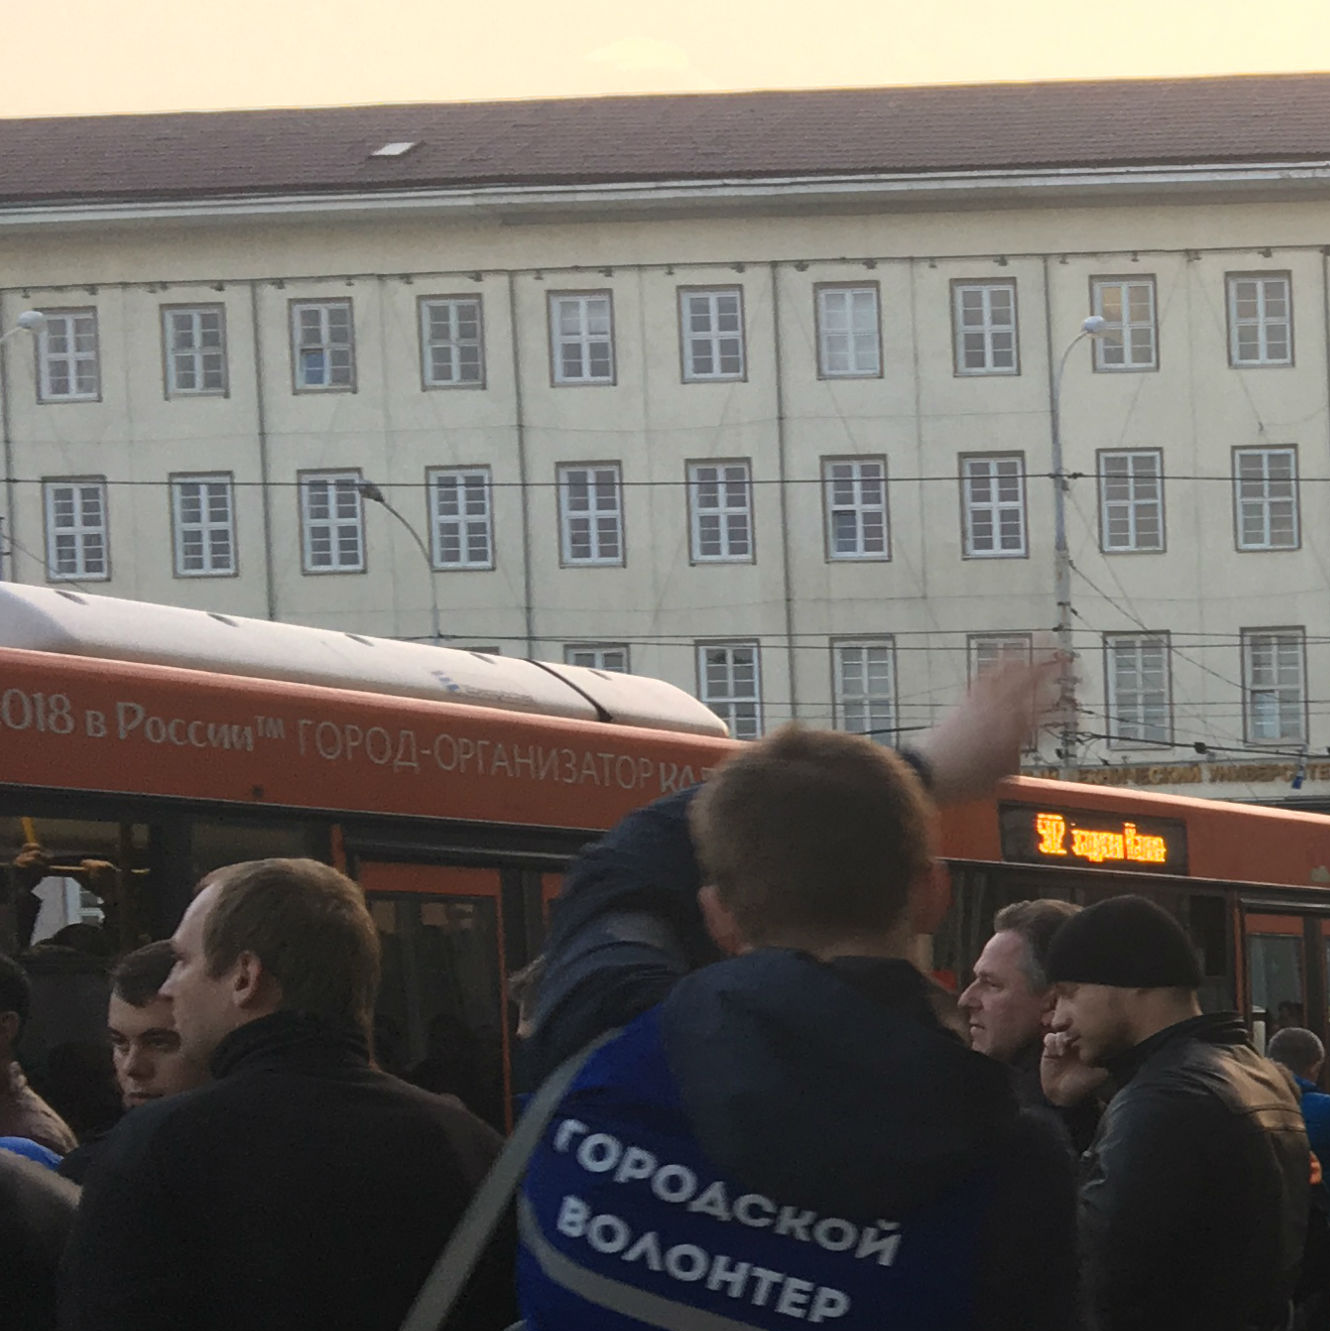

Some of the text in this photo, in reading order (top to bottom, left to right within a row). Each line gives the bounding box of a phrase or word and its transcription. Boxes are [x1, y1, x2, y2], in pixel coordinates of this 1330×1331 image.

[0, 688, 75, 735] 018
[84, 710, 107, 738] в
[298, 718, 653, 791] ГОРОД-ОРГАНИЗАТОР
[552, 1118, 902, 1266] ГОРОДСКОЙ
[557, 1195, 852, 1322] ВОЛОНТЕР
